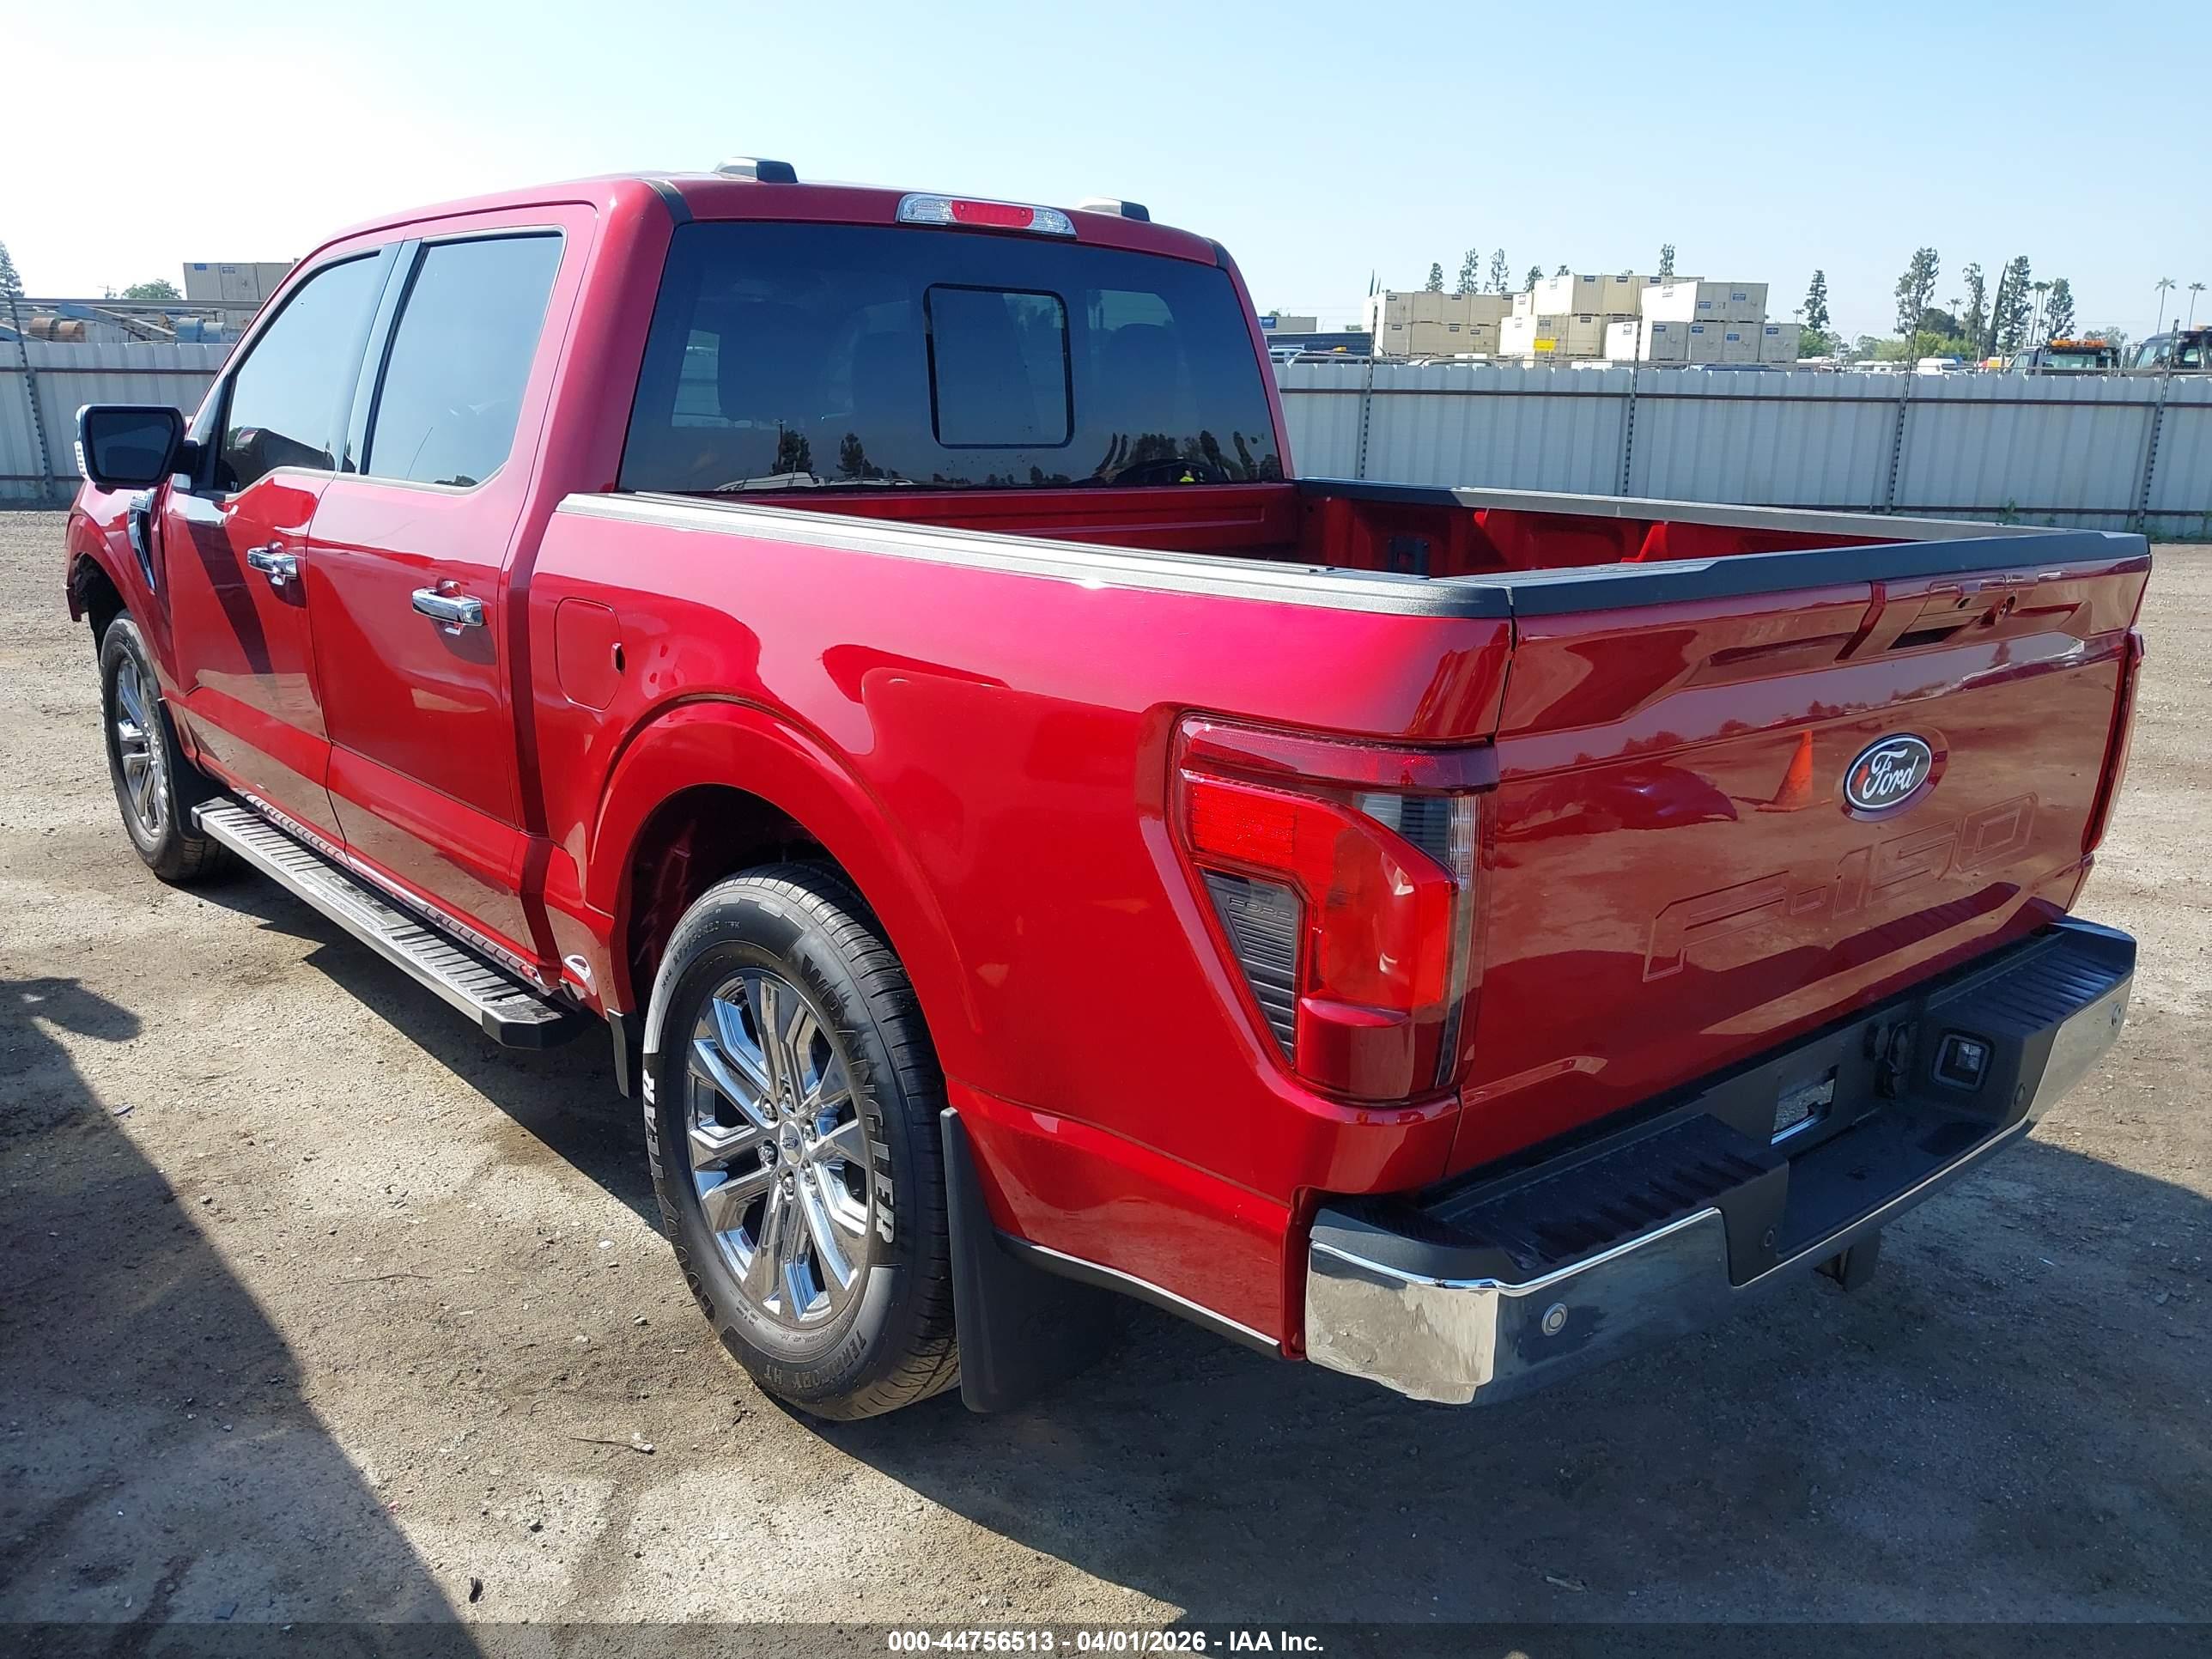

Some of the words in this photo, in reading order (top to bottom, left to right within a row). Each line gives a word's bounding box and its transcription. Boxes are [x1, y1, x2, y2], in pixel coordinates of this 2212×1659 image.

[1862, 747, 1921, 799] Ford
[1229, 897, 1293, 921] FORD
[1643, 791, 2039, 982] F-150
[800, 953, 896, 1243] WRANGLER
